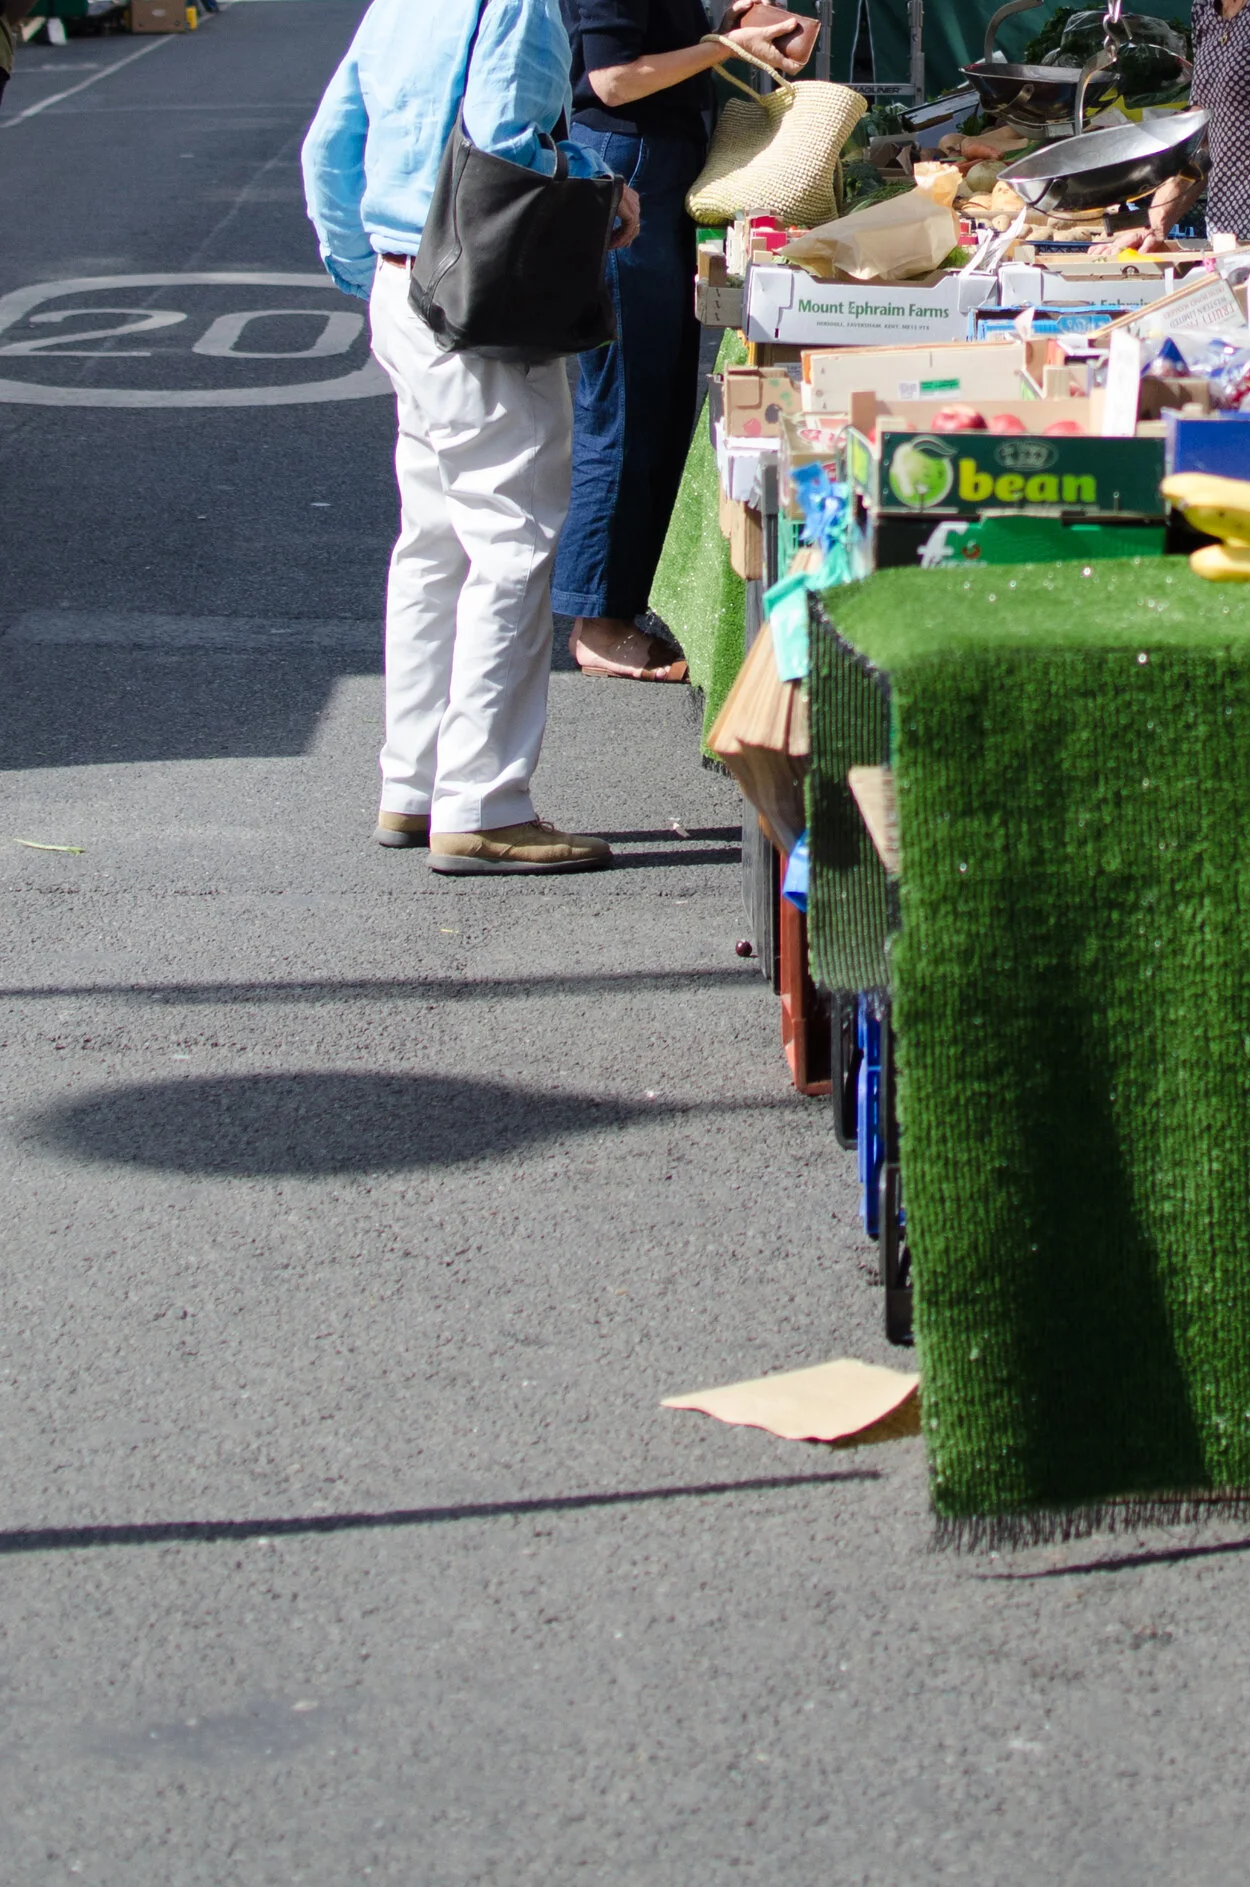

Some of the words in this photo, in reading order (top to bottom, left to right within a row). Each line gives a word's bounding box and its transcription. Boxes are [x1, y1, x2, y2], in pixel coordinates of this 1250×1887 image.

[798, 299, 844, 315] Mount
[848, 301, 905, 320] Ephraim
[908, 303, 950, 319] Farms
[0, 309, 364, 359] 20
[958, 457, 1097, 503] bean
